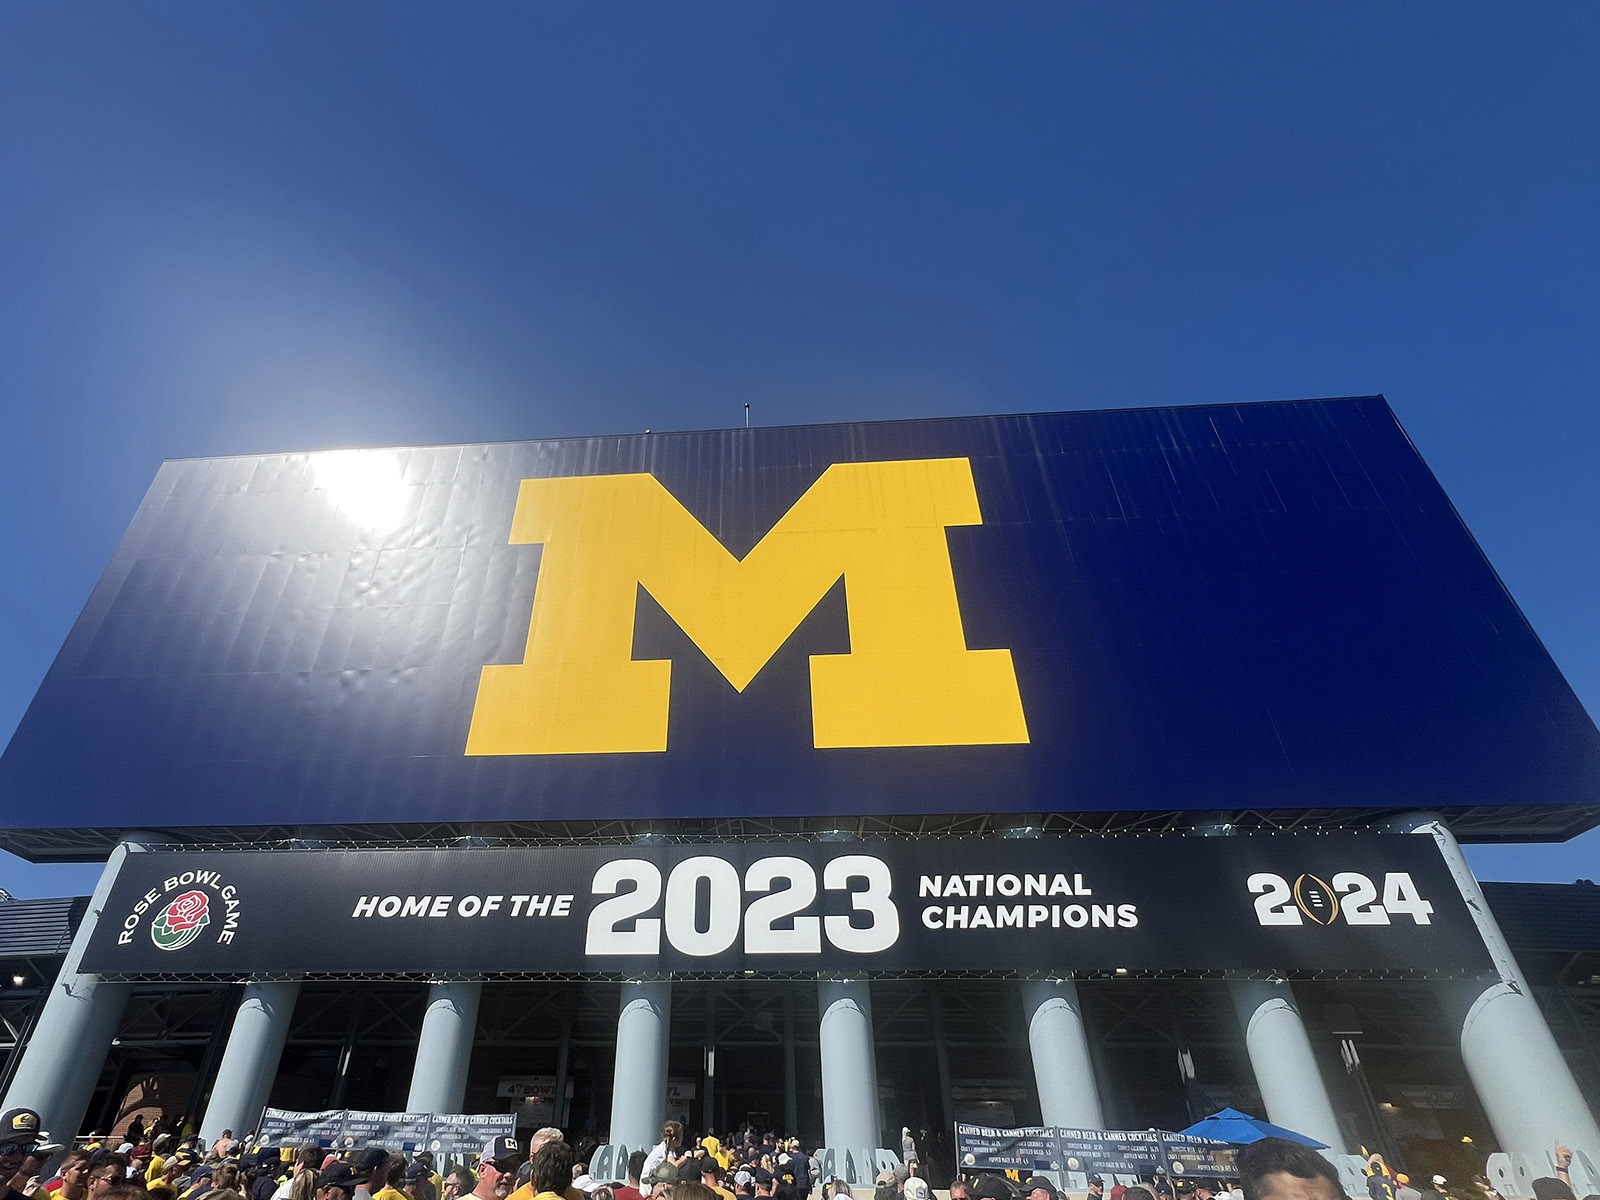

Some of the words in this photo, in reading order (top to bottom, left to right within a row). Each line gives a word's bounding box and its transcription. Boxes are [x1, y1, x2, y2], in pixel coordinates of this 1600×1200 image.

[464, 457, 1030, 756] M
[918, 873, 1093, 898] NATIONAL
[117, 887, 162, 946] ROSE
[163, 869, 222, 893] BOWL
[216, 884, 241, 946] GAME
[351, 895, 454, 919] HOME
[457, 895, 510, 918] OF
[510, 893, 575, 918] THE
[584, 855, 900, 957] 2023
[920, 903, 1140, 930] CHAMPIONS
[489, 1116, 513, 1125] COCKTAILS
[958, 1125, 980, 1136] CANNED
[981, 1128, 996, 1137] BEER
[1002, 1129, 1025, 1138] CANNED
[1025, 1128, 1055, 1138] COCKTAILS
[507, 1139, 517, 1148] M
[1060, 1129, 1081, 1139] CANNED
[1082, 1131, 1097, 1140] BEER
[1097, 1132, 1103, 1140] &
[1103, 1132, 1127, 1141] CANNED
[1127, 1133, 1158, 1142] COCKTAILS
[1162, 1133, 1186, 1142] CANNED
